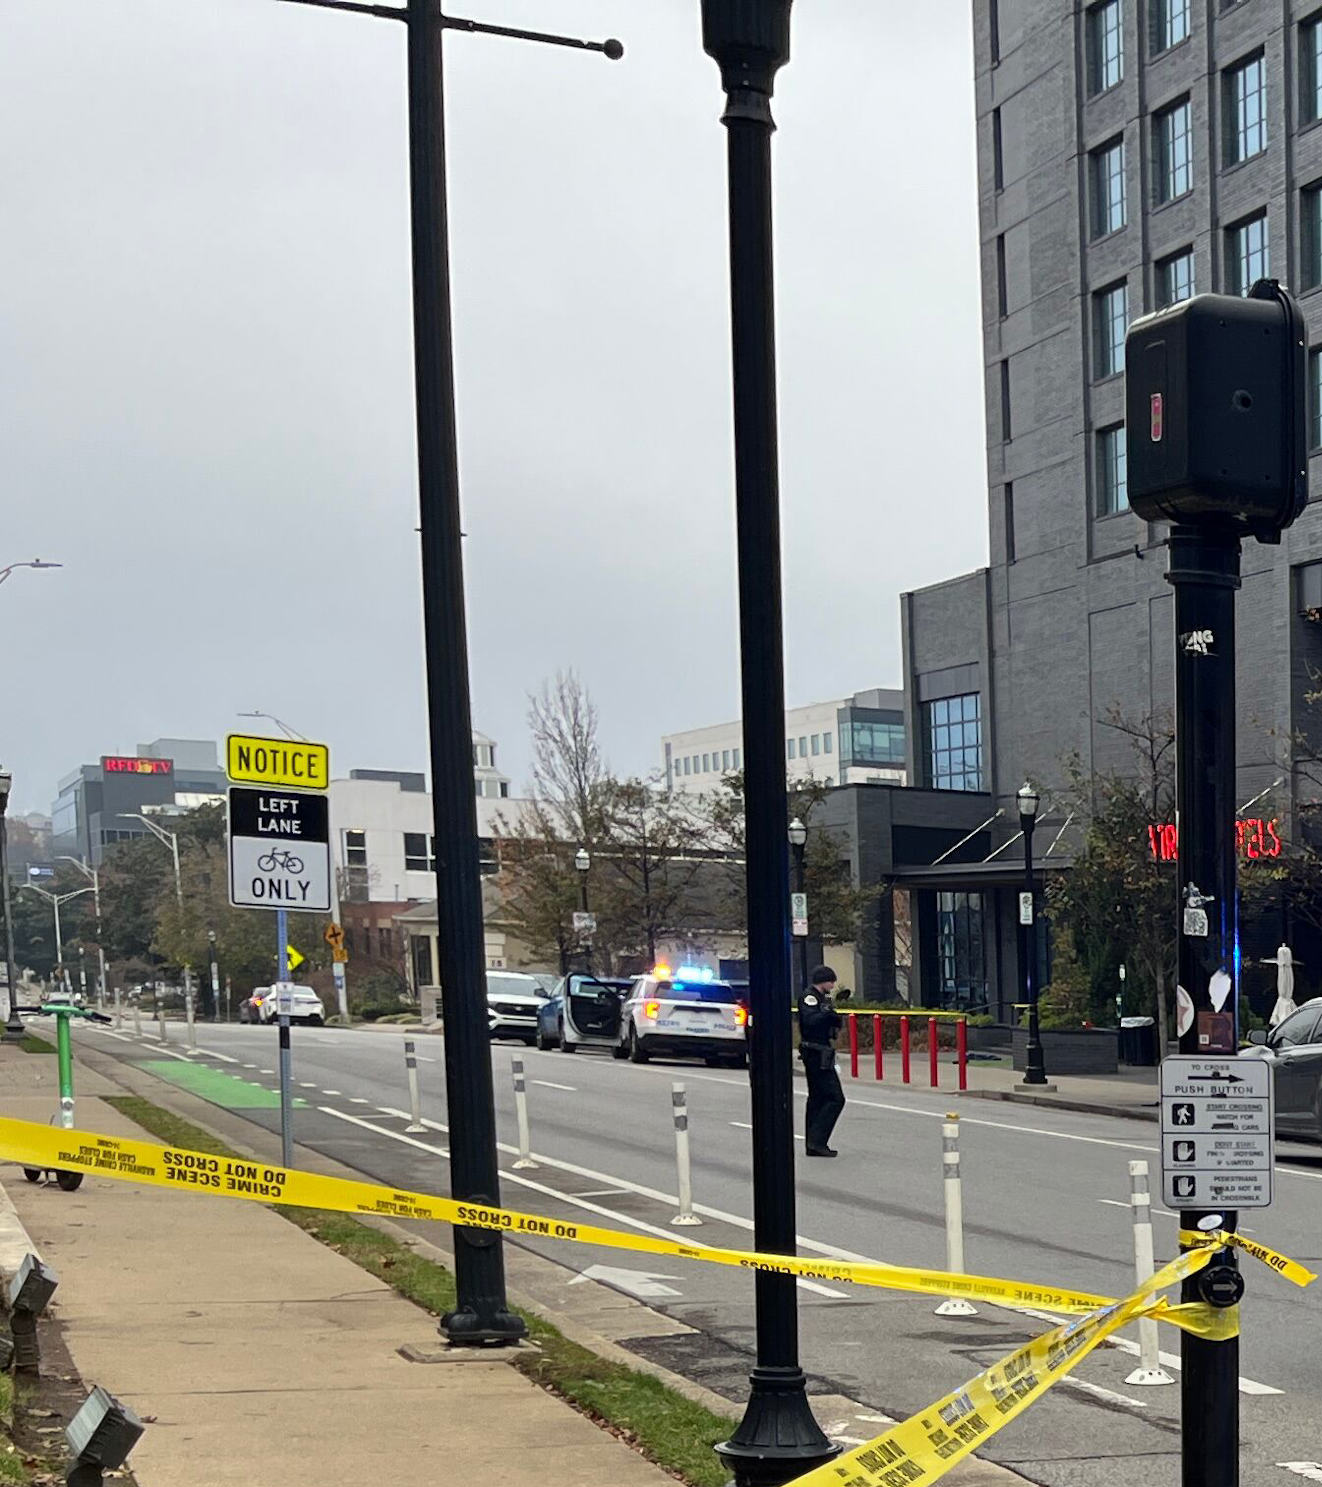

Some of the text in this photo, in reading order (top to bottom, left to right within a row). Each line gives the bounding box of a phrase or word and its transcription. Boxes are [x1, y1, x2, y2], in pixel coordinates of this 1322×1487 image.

[239, 746, 319, 779] NOTICE
[259, 797, 299, 814] LEFT
[258, 817, 302, 834] LANE
[252, 878, 311, 901] ONLY
[1175, 1086, 1254, 1094] PUSH BUTTON
[163, 1151, 286, 1185] DO NOT CROSS
[166, 1167, 281, 1197] CRIME SCENE
[457, 1206, 512, 1227] CROSS
[517, 1217, 549, 1233] NOT
[555, 1225, 577, 1239] DO
